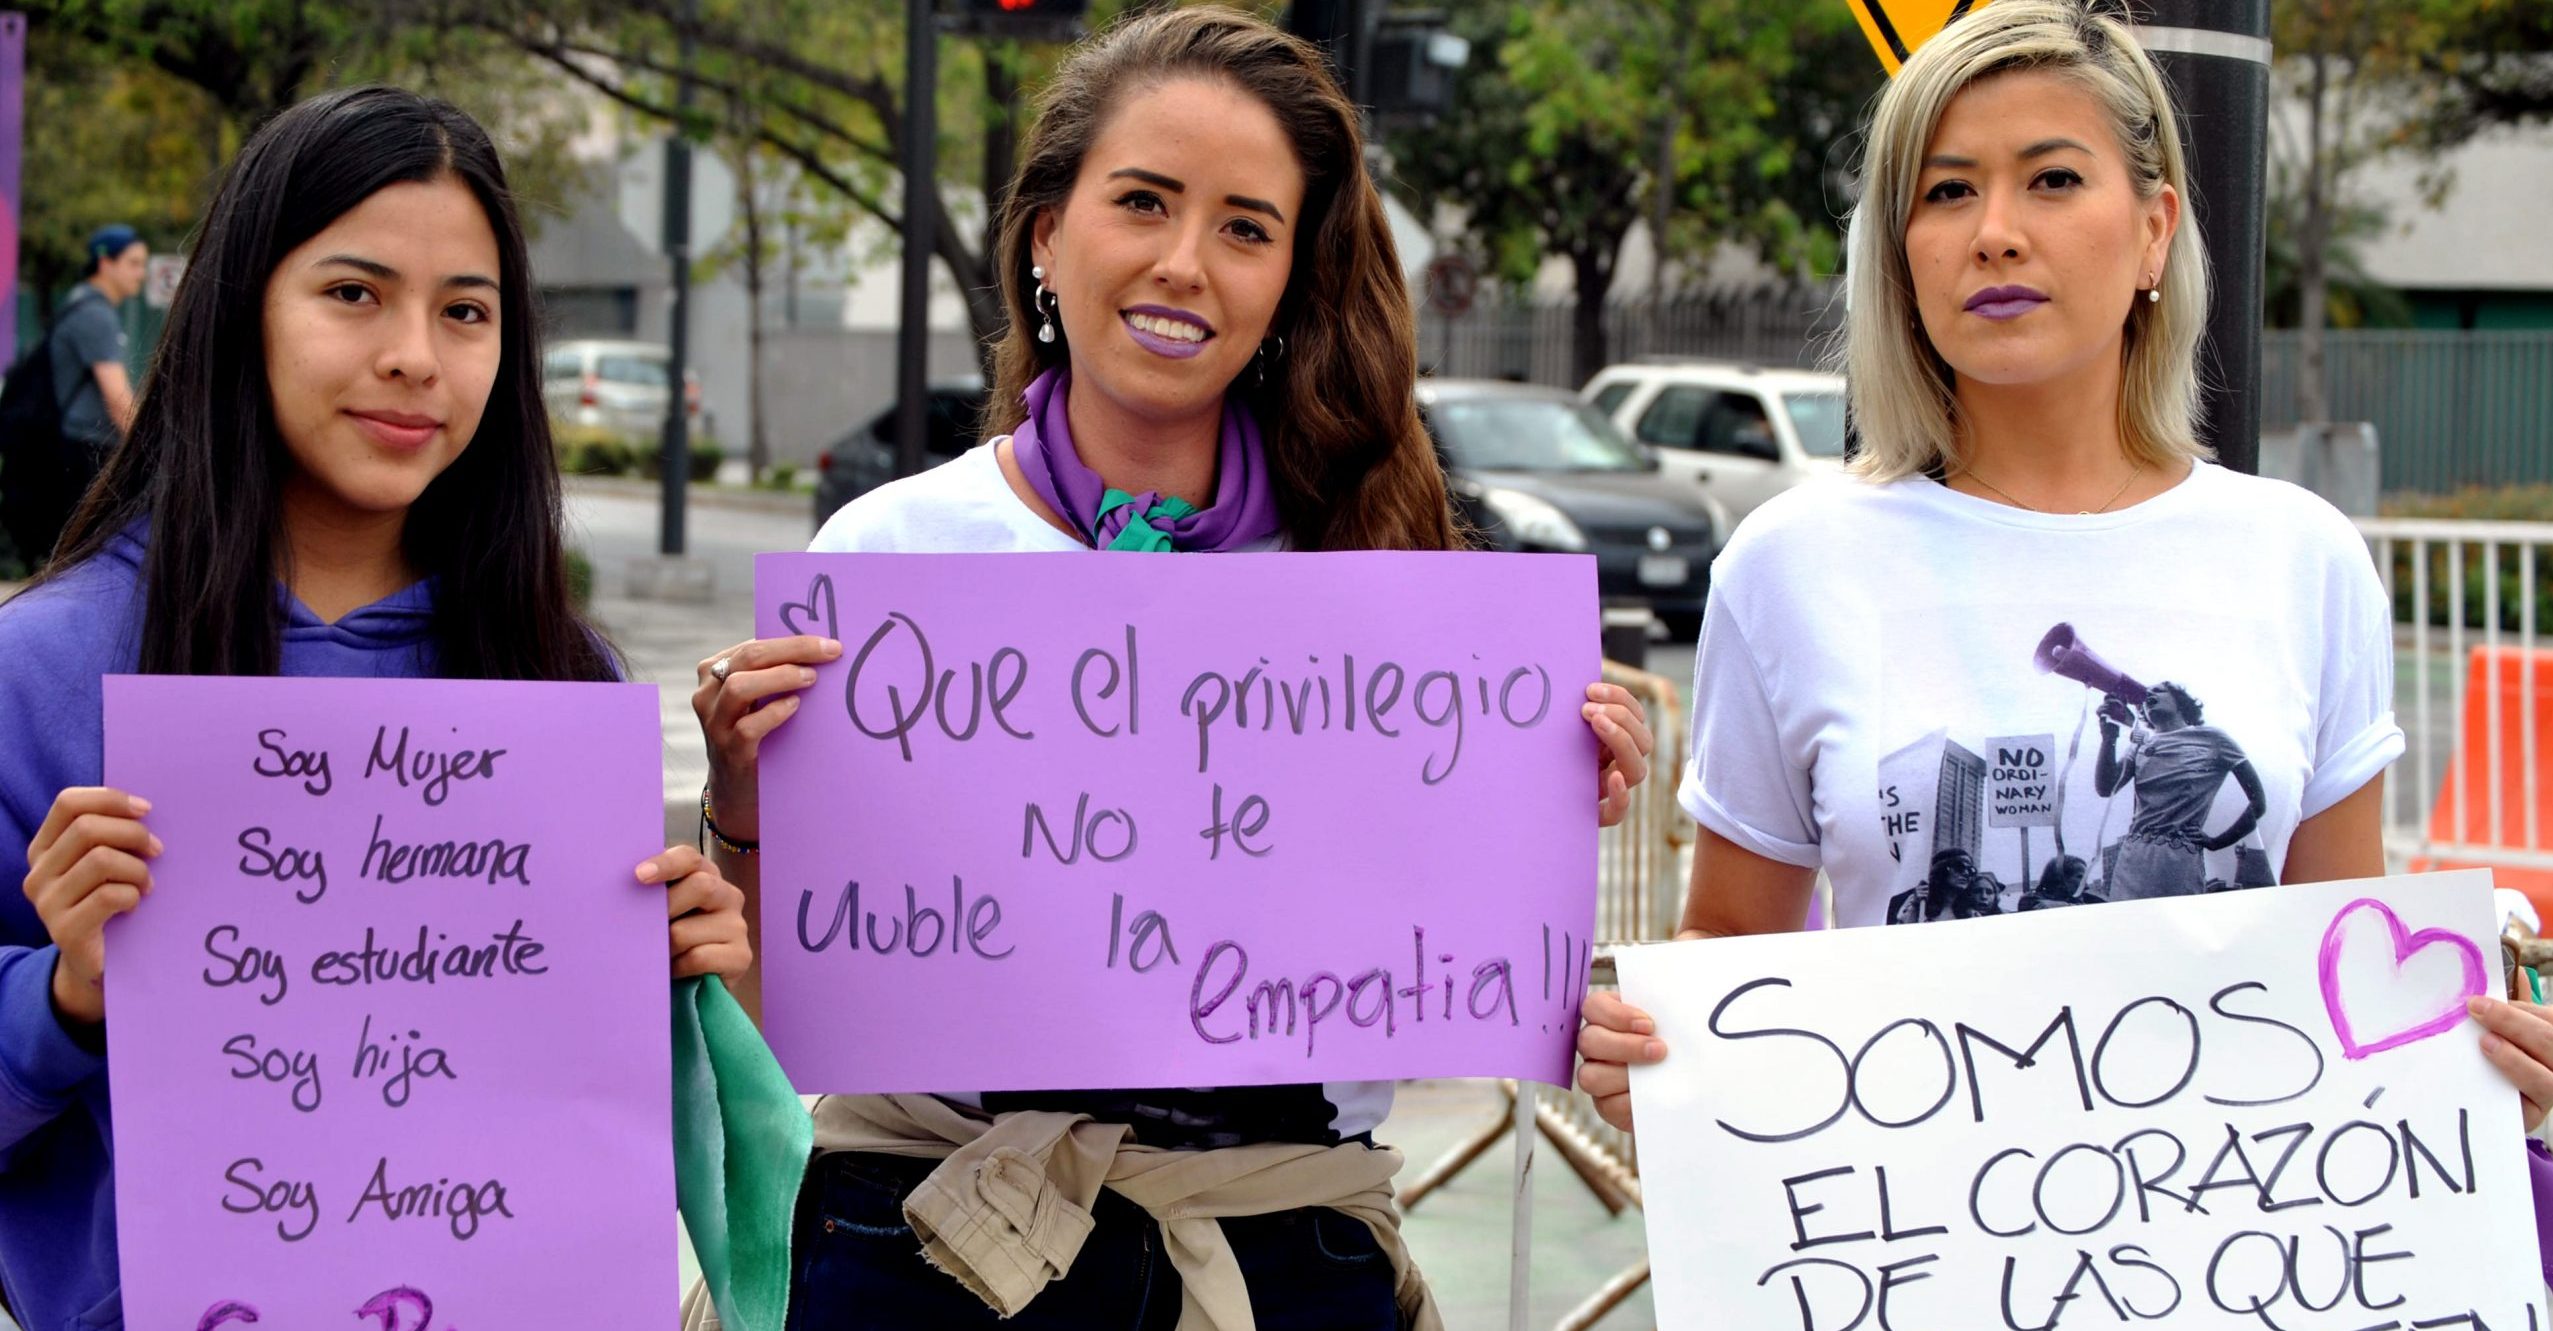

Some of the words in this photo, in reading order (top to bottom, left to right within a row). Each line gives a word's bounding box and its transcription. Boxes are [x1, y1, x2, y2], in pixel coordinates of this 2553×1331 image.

[845, 612, 1035, 762] Que
[1071, 624, 1139, 738] el
[1181, 654, 1551, 786] privilegio
[254, 729, 332, 796] Soy
[364, 726, 507, 806] Mujer
[1992, 767, 2048, 782] ORDI-
[1995, 785, 2046, 800] NARY
[1999, 748, 2045, 767] NO
[1200, 783, 1274, 860] te
[1881, 811, 1921, 837] HE
[1995, 803, 2052, 815] WOMAN
[238, 827, 327, 904] Soy
[360, 814, 531, 885] hermana
[203, 925, 288, 1005] Soy
[311, 919, 549, 986] estudiante
[1107, 892, 1181, 974] la
[222, 1034, 322, 1112] Soy
[353, 1015, 458, 1107] hija
[1708, 976, 2324, 1143] SOMOS
[222, 1158, 320, 1242] Soy
[347, 1157, 515, 1240] Amiga
[1782, 1166, 1949, 1251] EL
[1969, 1087, 2477, 1237] CORAZÓN
[2001, 1244, 2182, 1331] LAS
[2206, 1223, 2415, 1331] QUE
